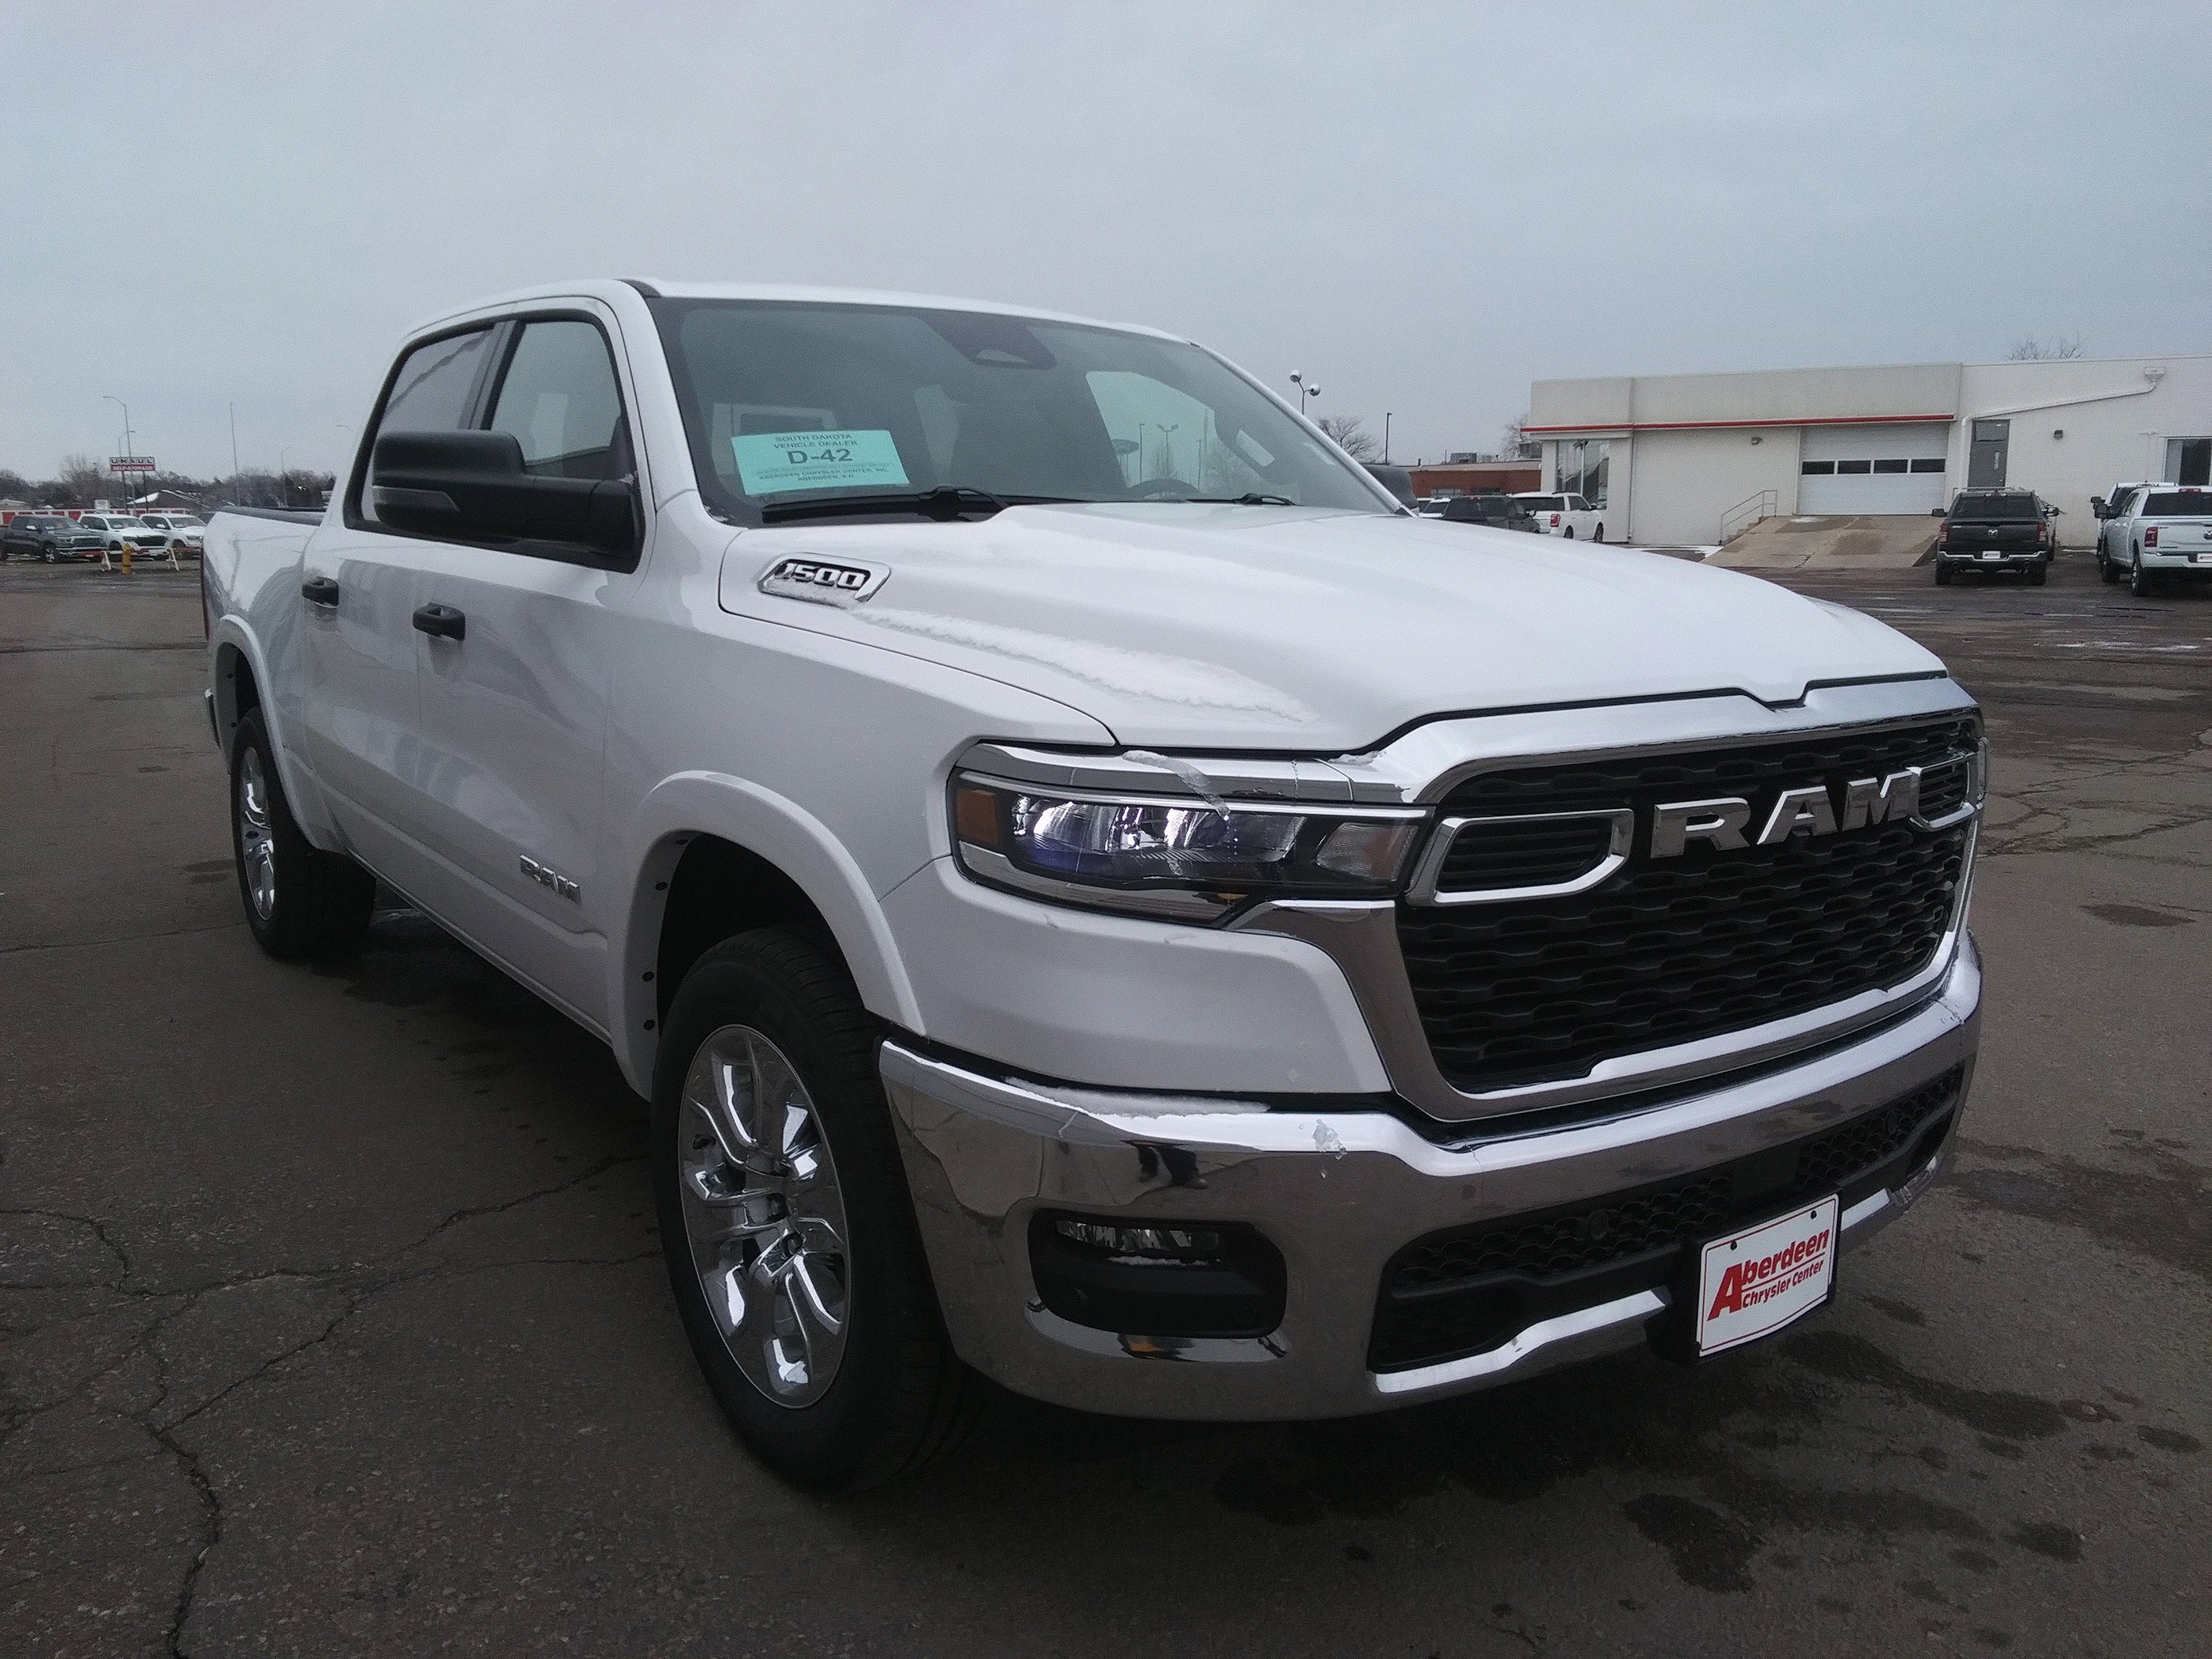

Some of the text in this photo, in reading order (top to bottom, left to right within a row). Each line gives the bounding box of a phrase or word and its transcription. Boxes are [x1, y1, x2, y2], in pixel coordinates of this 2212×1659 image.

[787, 449, 853, 465] D-42
[774, 562, 867, 588] 1500
[1650, 771, 1918, 859] RAM
[1706, 1229, 1830, 1322] Aberdeen
[1742, 1260, 1824, 1309] Chrysler Center
